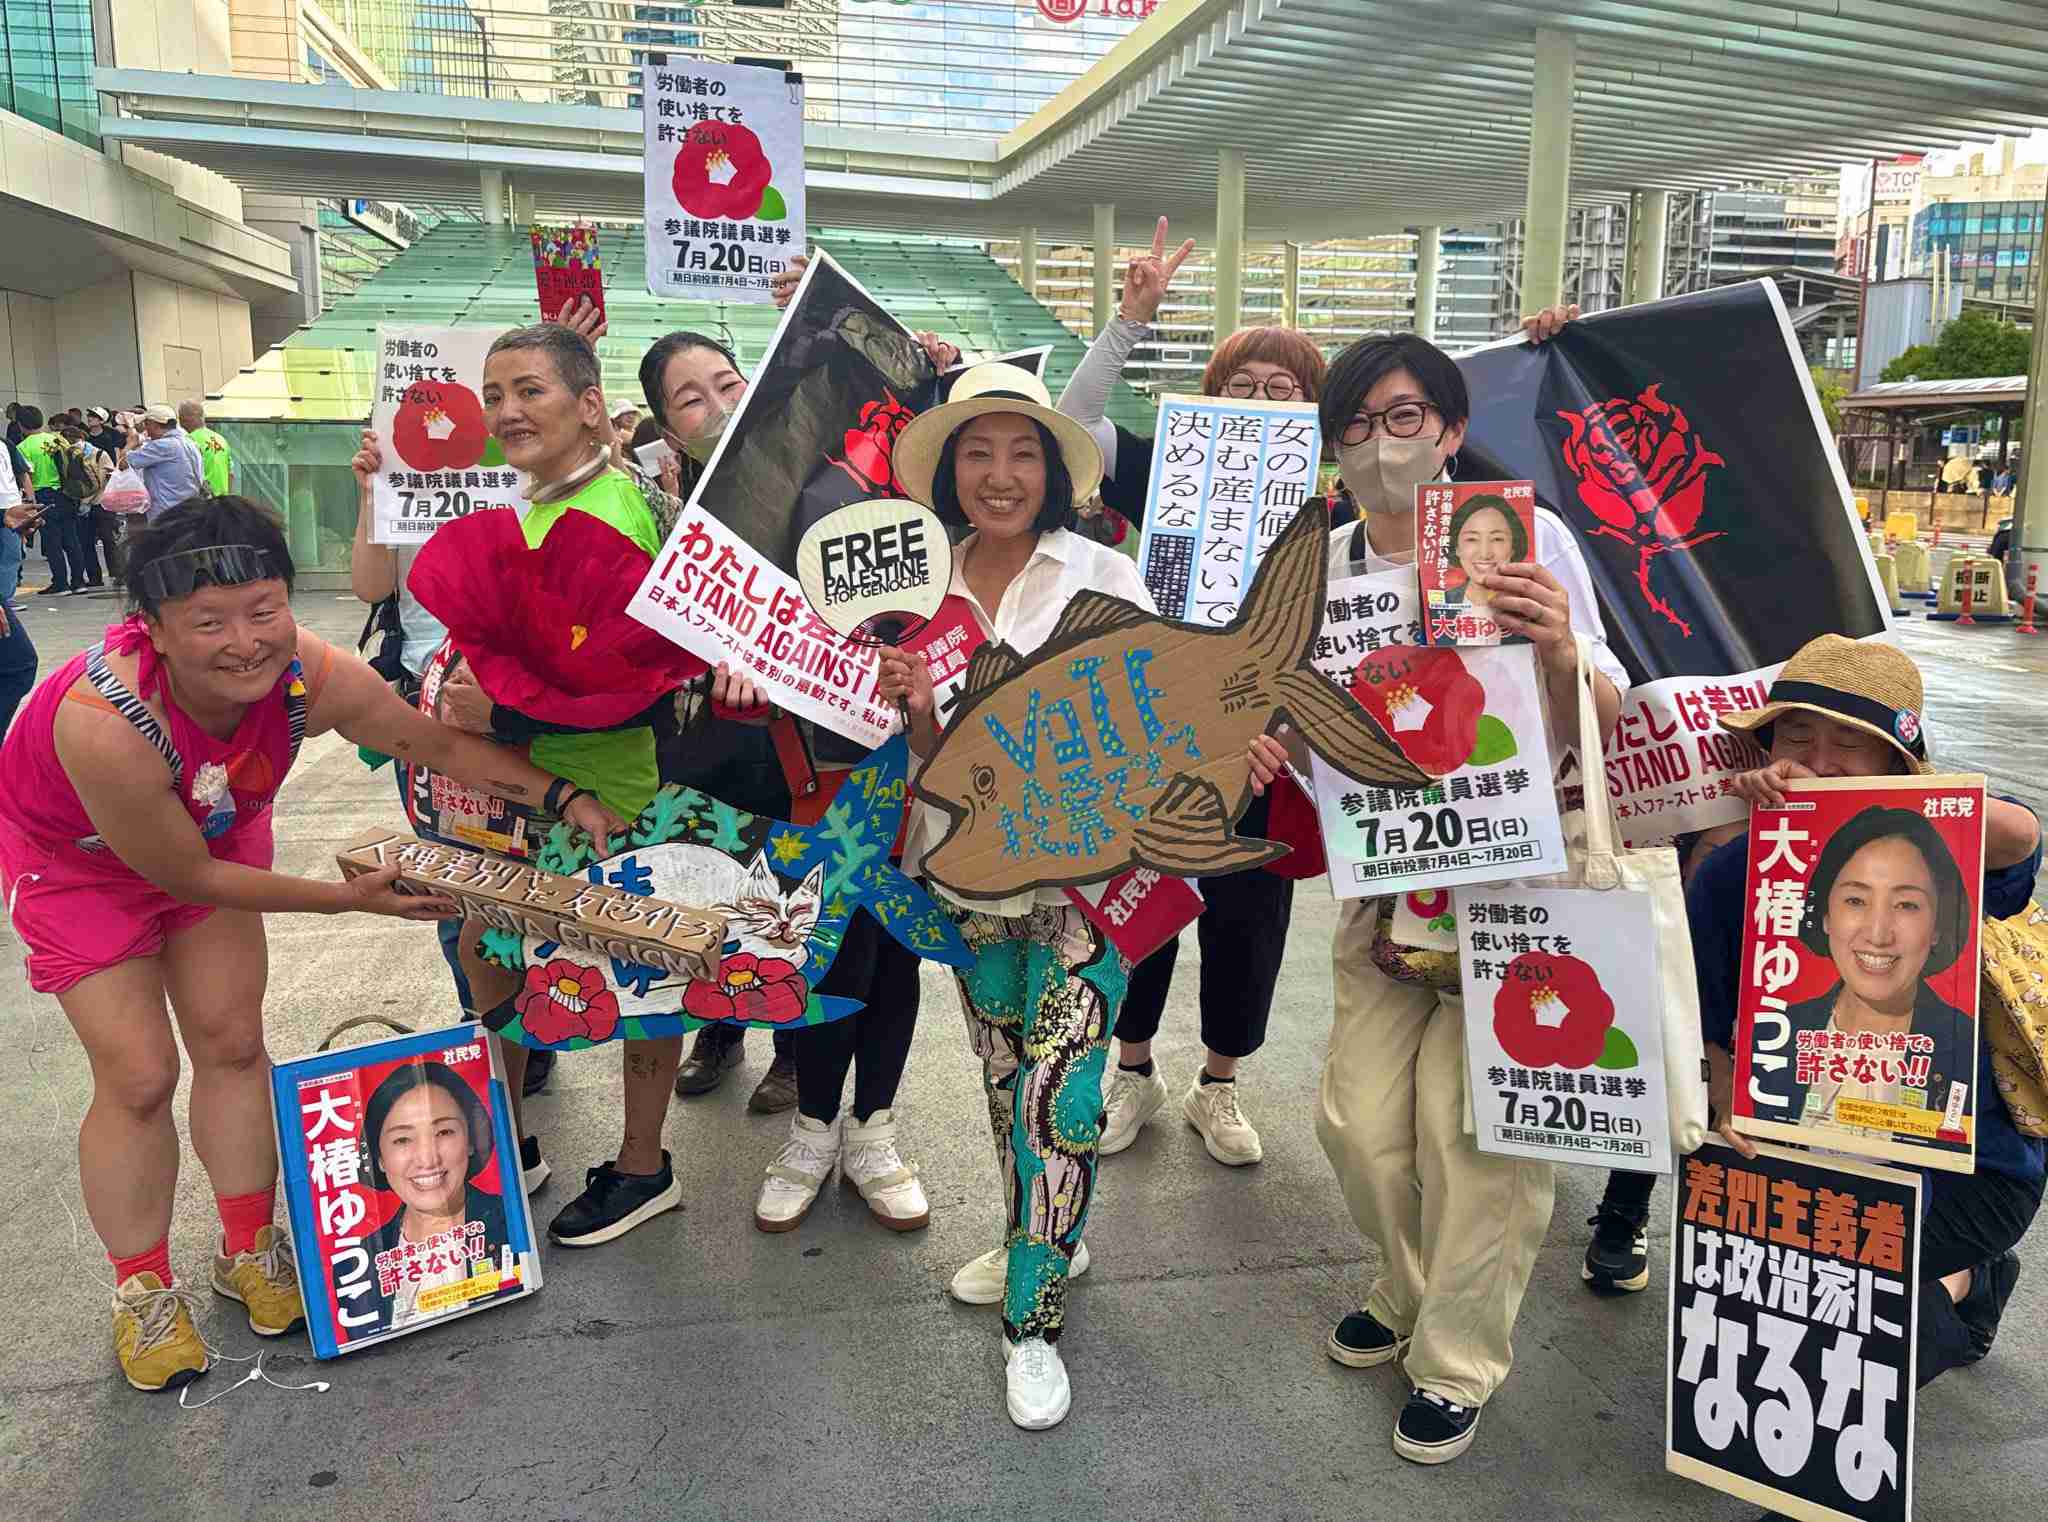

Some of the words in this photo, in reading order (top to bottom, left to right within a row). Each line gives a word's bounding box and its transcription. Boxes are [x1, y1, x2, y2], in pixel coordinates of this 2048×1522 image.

[657, 73, 727, 97] 労働者の
[657, 99, 743, 124] 使い捨てを
[657, 124, 728, 145] 許さない
[664, 218, 792, 245] 参議院議員選挙
[672, 240, 787, 275] 7月20日(日)
[384, 339, 438, 358] 労働者の
[383, 363, 457, 383] 使い捨てを
[382, 386, 444, 404] 許さない
[388, 471, 519, 489] 参議院議員選挙
[1157, 410, 1213, 528] 決めるな
[1503, 486, 1534, 499] 社民党
[1195, 415, 1264, 625] 産む産まないで
[820, 518, 928, 579] FREE
[1437, 490, 1454, 589] 労働者の使い捨てを
[825, 559, 929, 595] PALESTINE
[825, 588, 858, 607] STOP
[861, 573, 930, 598] GENOCIDE
[660, 551, 680, 581] I
[675, 561, 758, 637] STAND
[754, 621, 870, 696] AGAINST
[1326, 591, 1400, 625] 働者の
[983, 648, 1168, 775] VOTE
[1605, 741, 1691, 799] STAND
[849, 762, 905, 818] 7/20
[1340, 767, 1530, 817] 参議院議員選挙
[1923, 797, 1975, 818] 社民党
[1356, 807, 1529, 859] 7月20日(日)
[1104, 866, 1161, 926] 社民党
[1468, 903, 1549, 925] 労働者の
[1470, 931, 1572, 955] 使い捨てを
[1472, 959, 1553, 981] 許さない
[1748, 817, 1809, 1108] 大椿ゆうこ
[443, 1044, 482, 1065] 社民党
[1796, 1030, 1934, 1053] 労働者の使い捨てを
[1488, 1065, 1647, 1098] 参議院議員選挙
[1498, 1090, 1642, 1137] 7月20日(日)
[302, 1088, 380, 1328] 大椿ゆうこ
[1685, 1158, 1907, 1274] 差別主義者
[376, 1221, 486, 1269] 労働者の使い捨てを
[1682, 1222, 1905, 1339] は政治家に
[1677, 1292, 1900, 1503] なるな
